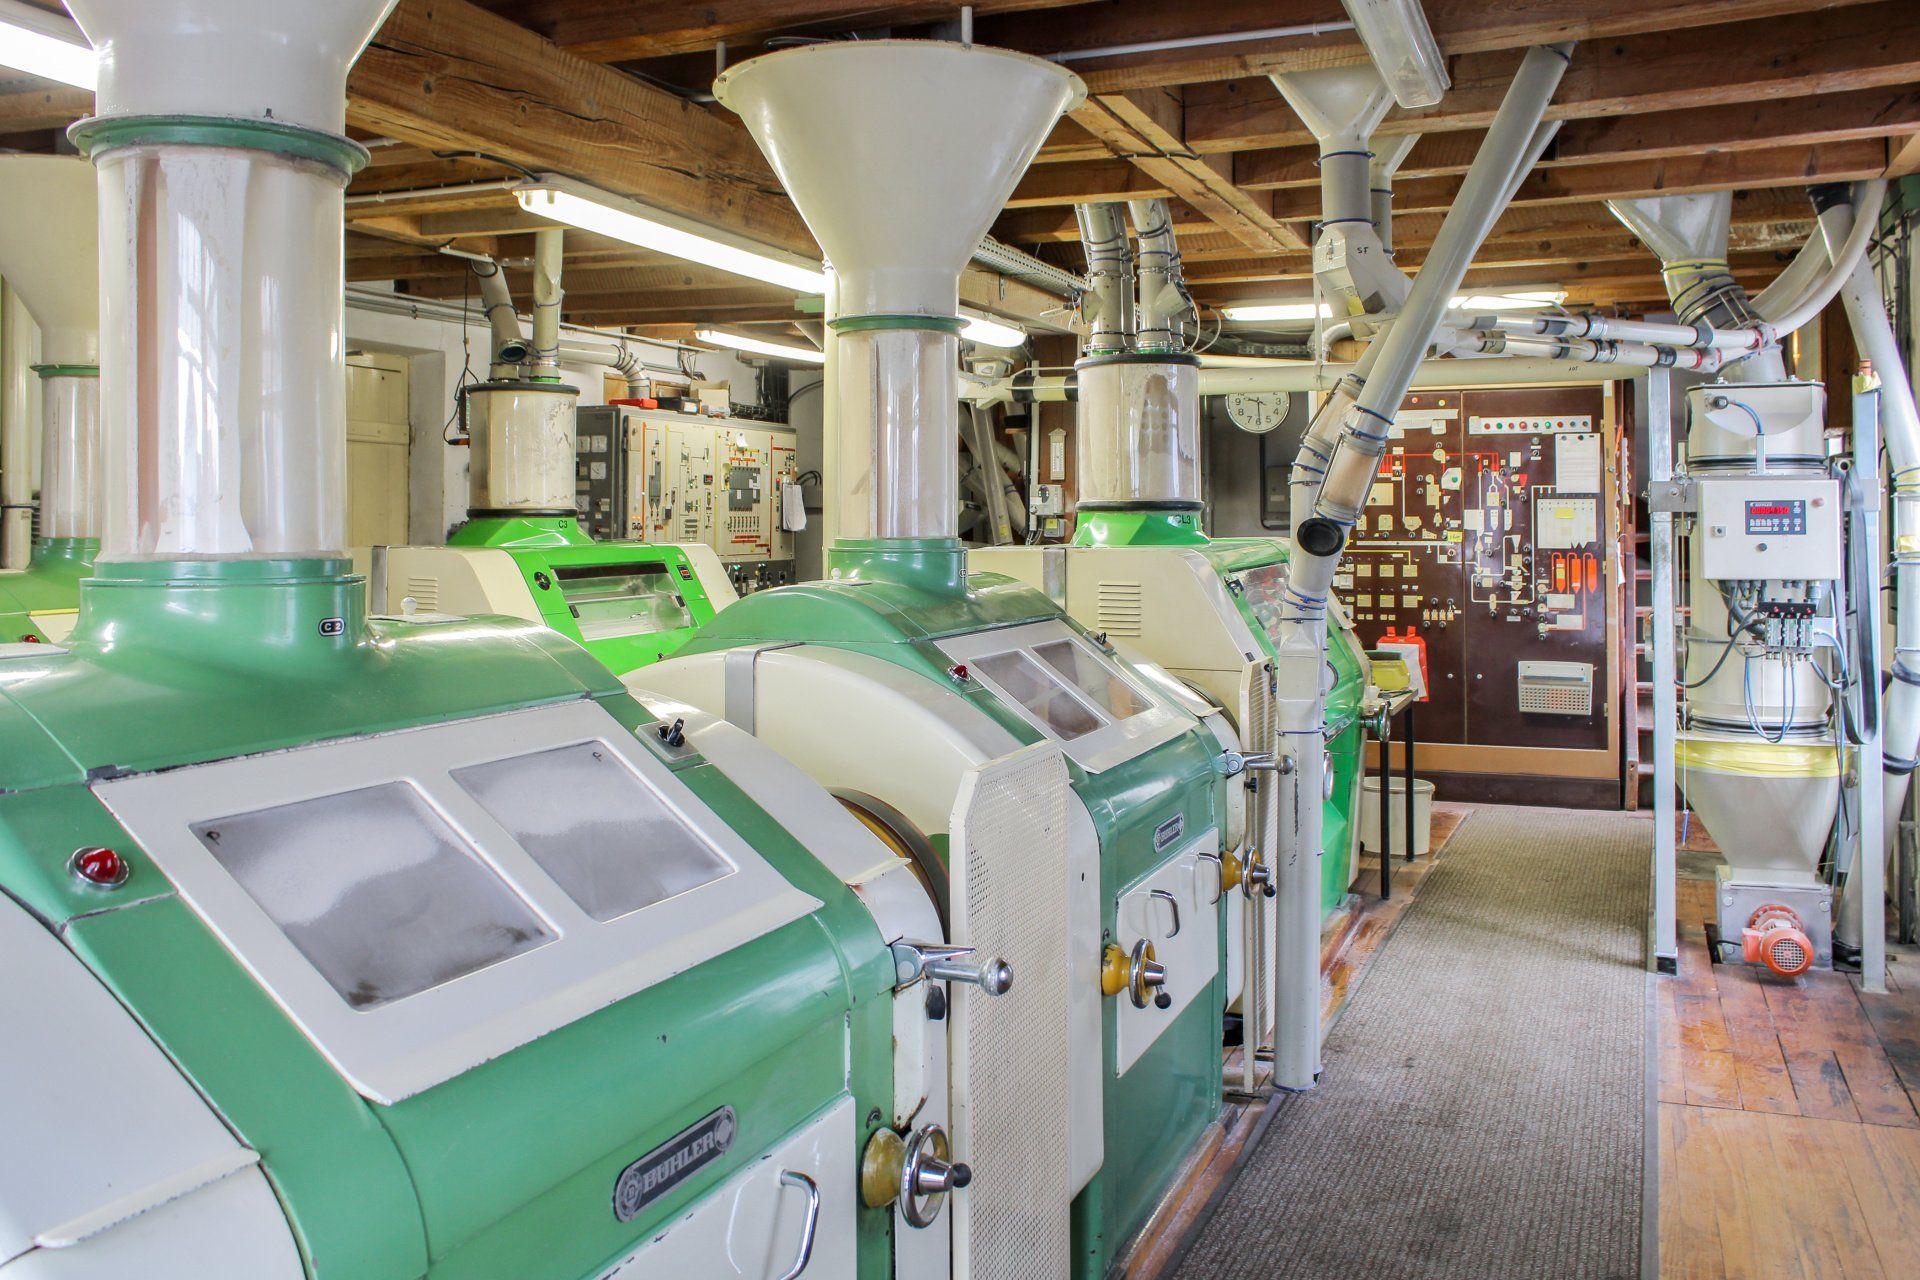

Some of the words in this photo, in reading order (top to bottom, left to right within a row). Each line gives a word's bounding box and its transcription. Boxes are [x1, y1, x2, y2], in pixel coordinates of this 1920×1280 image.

[1235, 398, 1241, 406] 9
[1276, 398, 1282, 406] 3
[1238, 408, 1244, 416] 8
[1273, 408, 1279, 416] 4
[1255, 418, 1262, 426] 6
[558, 520, 568, 529] C3
